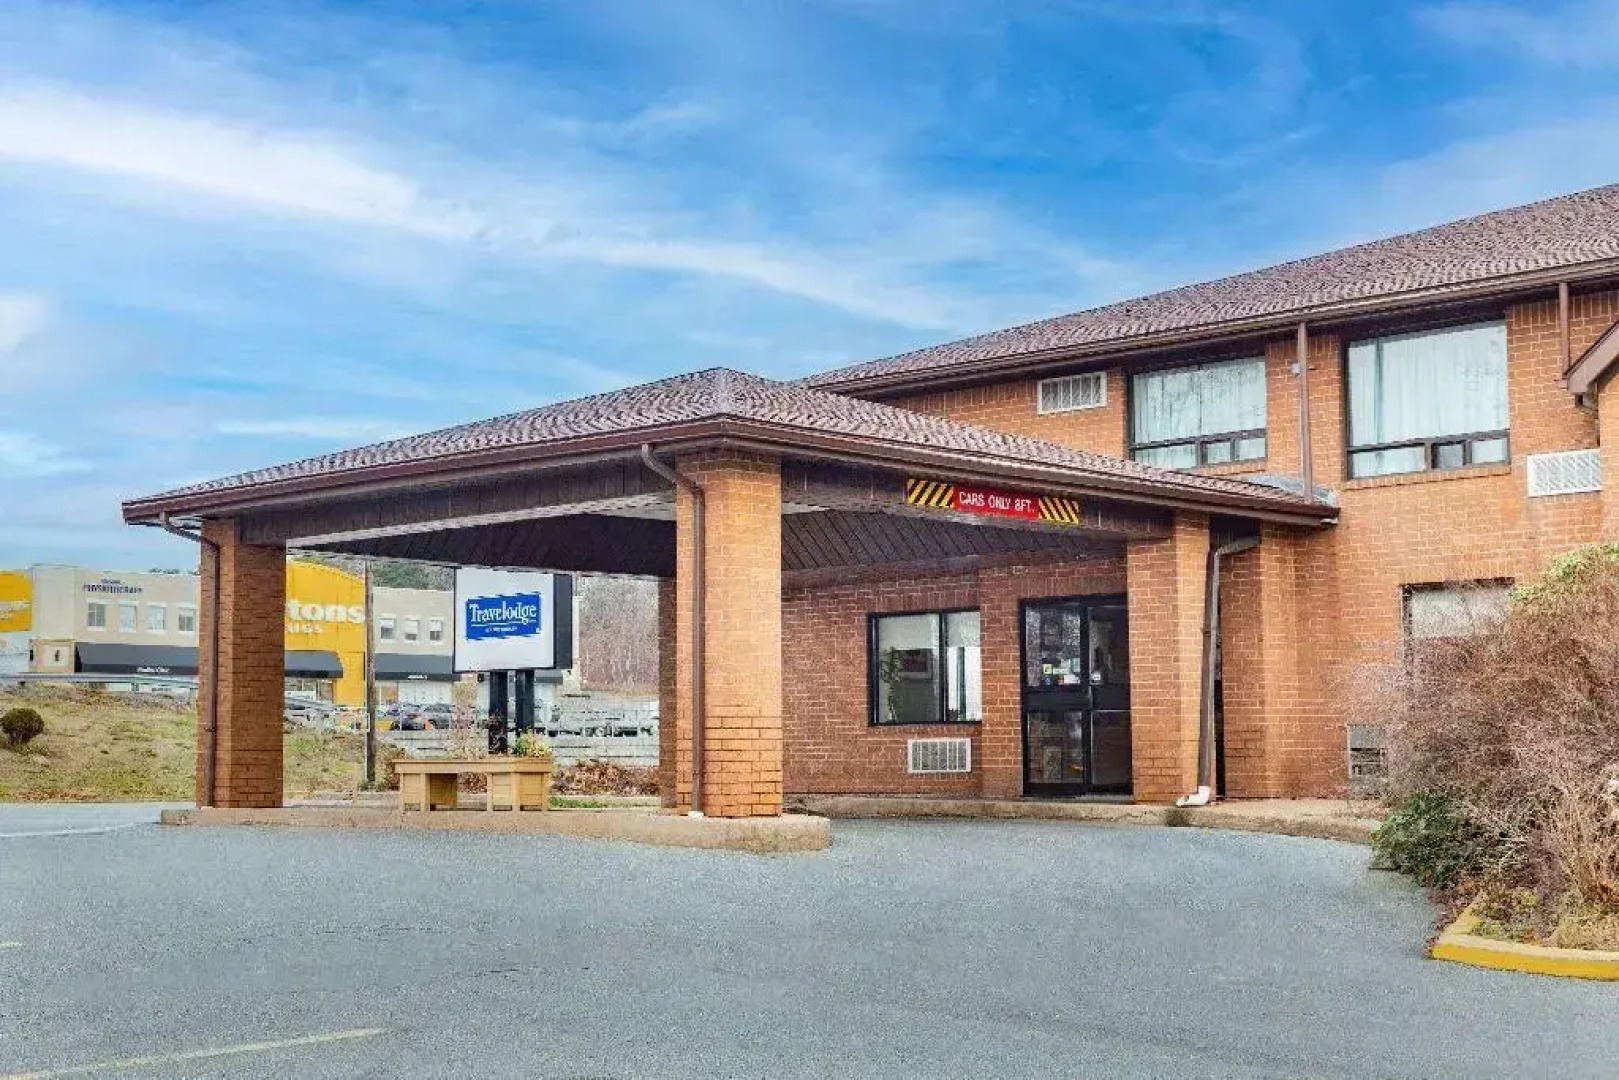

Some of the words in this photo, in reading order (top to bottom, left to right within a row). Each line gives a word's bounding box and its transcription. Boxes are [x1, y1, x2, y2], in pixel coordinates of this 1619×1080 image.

[959, 491, 985, 507] CARS
[988, 495, 1011, 511] ONLY
[1014, 499, 1035, 513] 8FT.
[469, 601, 537, 625] Travelodge
